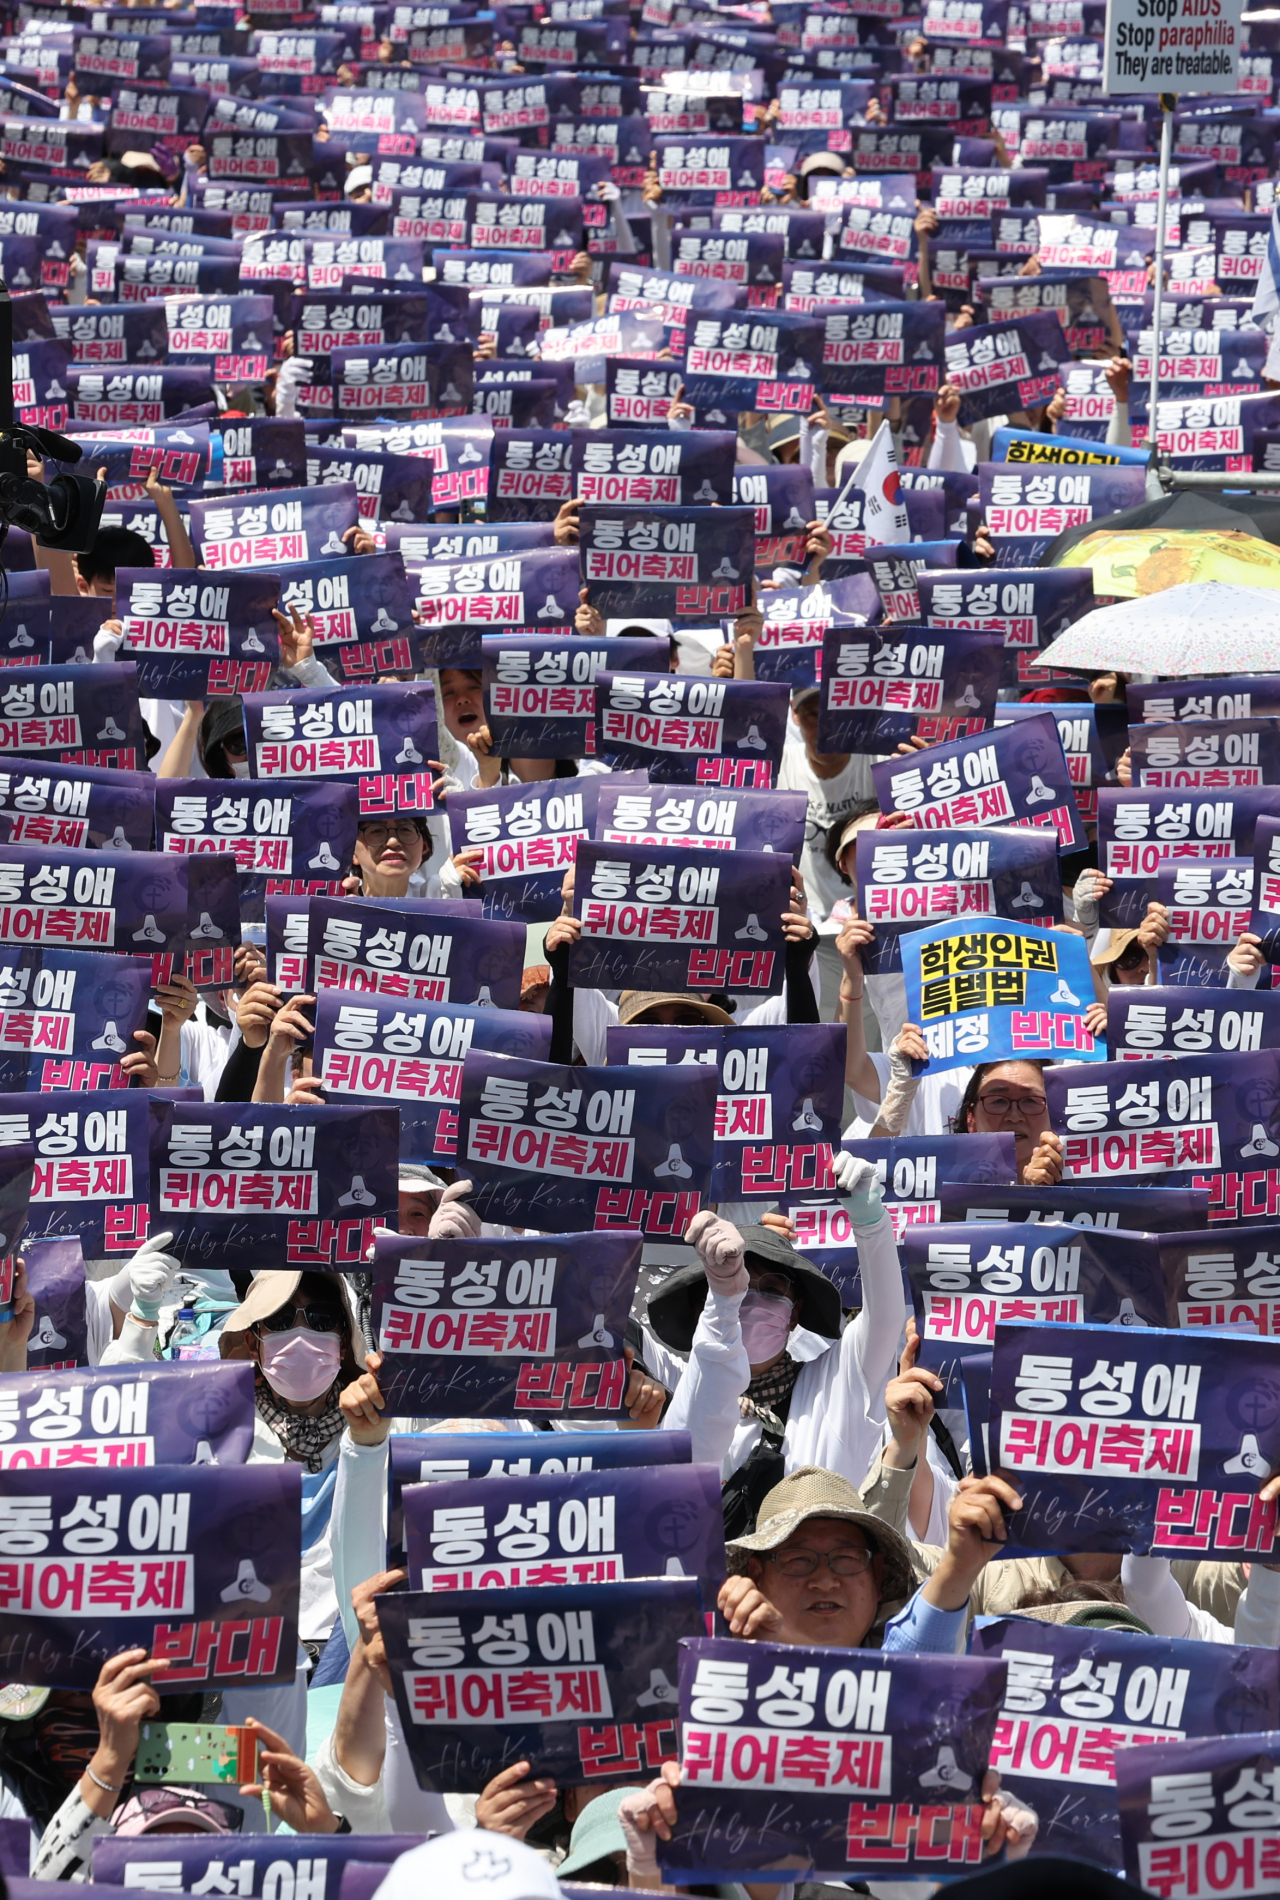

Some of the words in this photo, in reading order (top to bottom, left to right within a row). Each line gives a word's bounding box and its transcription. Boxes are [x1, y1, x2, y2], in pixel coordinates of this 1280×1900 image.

[1117, 21, 1154, 51] Stop
[1159, 20, 1234, 51] paraphilia
[1116, 51, 1147, 81] They
[1152, 57, 1172, 74] are
[1176, 52, 1232, 75] treatable.
[212, 160, 276, 176] 퀴어축제
[379, 162, 446, 189] 동성애
[516, 156, 578, 179] 동성애
[662, 170, 727, 187] 퀴어축제
[515, 178, 576, 196] 퀴어축제
[816, 180, 880, 197] 동성애
[940, 175, 1009, 198] 동성애
[400, 197, 467, 220] 동성애
[476, 202, 545, 226] 동성애
[850, 210, 912, 236] 동성애
[937, 198, 1006, 217] 퀴어축제
[398, 220, 464, 240] 퀴어축제
[474, 228, 542, 246] 퀴어축제
[845, 231, 908, 254] 퀴어축제
[311, 240, 384, 264] 동성애
[679, 239, 748, 260] 동성애
[1040, 246, 1114, 266] 퀴어축제
[124, 260, 199, 283] 동성애
[444, 260, 513, 284] 동성애
[678, 261, 745, 281] 퀴어축제
[791, 271, 863, 296] 동성애
[1100, 270, 1146, 294] 반대
[302, 305, 382, 330] 동성애
[826, 314, 902, 340] 동성애
[694, 321, 778, 350] 동성애
[824, 343, 900, 362] 퀴어축제
[946, 330, 1021, 363] 동성애
[216, 356, 267, 381] 반대
[344, 357, 426, 384] 동성애
[690, 351, 775, 376] 퀴어축제
[884, 366, 939, 392] 반대
[949, 354, 1029, 388] 퀴어축제
[78, 375, 162, 400] 동성애
[341, 387, 425, 406] 퀴어축제
[756, 384, 815, 411] 반대
[76, 404, 161, 422] 퀴어축제
[584, 442, 681, 474] 동성애
[1158, 432, 1242, 455] 퀴어축제
[131, 448, 200, 484] 반대
[432, 468, 488, 502] 반대
[580, 475, 678, 502] 퀴어축제
[990, 476, 1089, 502] 동성애
[204, 502, 302, 538] 동성애
[592, 519, 695, 552] 동성애
[204, 534, 304, 568] 퀴어축제
[589, 551, 696, 580] 퀴어축제
[420, 560, 520, 594] 동성애
[131, 582, 229, 618] 동성애
[419, 590, 520, 625] 퀴어축제
[676, 585, 744, 614] 반대
[932, 584, 1034, 614] 동성애
[126, 620, 226, 654] 퀴어축제
[341, 635, 411, 678] 반대
[496, 651, 606, 682] 동성애
[836, 645, 944, 675] 동성애
[208, 660, 270, 694] 반대
[610, 676, 725, 716] 동성애
[829, 679, 942, 711] 퀴어축제
[261, 700, 372, 739] 동성애
[602, 711, 722, 750] 퀴어축제
[259, 736, 375, 775] 퀴어축제
[1146, 734, 1258, 765] 동성애
[696, 758, 772, 788] 반대
[890, 746, 999, 810] 동성애
[359, 772, 434, 812] 반대
[171, 798, 292, 835] 동성애
[465, 794, 584, 841] 동성애
[613, 790, 737, 835] 동성애
[1112, 802, 1234, 839] 동성애
[872, 841, 989, 880] 동성애
[0, 865, 114, 905] 동성애
[591, 861, 720, 906] 동성애
[869, 882, 989, 919] 퀴어축제
[582, 903, 718, 942] 퀴어축제
[324, 918, 450, 975] 동성애
[921, 935, 1056, 974] 학생인권
[688, 949, 775, 988] 반대
[922, 974, 1026, 1018] 특별법
[335, 1008, 475, 1056] 동성애
[925, 1018, 989, 1059] 제정
[1012, 1011, 1092, 1050] 반대
[1124, 1006, 1264, 1050] 동성애
[322, 1052, 462, 1099] 퀴어축제
[481, 1078, 636, 1135] 동성애
[1065, 1078, 1212, 1131] 동성애
[168, 1124, 316, 1169] 동성애
[472, 1122, 631, 1178] 퀴어축제
[1066, 1125, 1214, 1174] 퀴어축제
[742, 1145, 836, 1192] 반대
[162, 1172, 315, 1210] 퀴어축제
[467, 1180, 530, 1215] Holy
[529, 1182, 589, 1210] Korea
[595, 1188, 701, 1236] 반대
[286, 1218, 376, 1264] 반대
[394, 1258, 556, 1305] 동성애
[928, 1245, 1081, 1291] 동성애
[384, 1308, 551, 1352] 퀴어축제
[382, 1372, 445, 1412] Holy
[445, 1372, 512, 1398] Korea
[515, 1361, 625, 1409] 반대
[1014, 1356, 1201, 1420] 동성애
[1002, 1416, 1196, 1475] 퀴어축제
[1072, 1490, 1152, 1522] Korea
[1154, 1489, 1278, 1552] 반대
[0, 1494, 191, 1554] 동성애
[430, 1498, 615, 1562] 동성애
[0, 1558, 188, 1611] 퀴어축제
[152, 1618, 284, 1682] 반대
[409, 1611, 596, 1665] 동성애
[414, 1672, 602, 1720] 퀴어축제
[690, 1660, 891, 1732] 동성애
[1002, 1650, 1190, 1728] 동성애
[685, 1728, 885, 1789] 퀴어축제
[675, 1805, 755, 1852] Holy
[752, 1805, 832, 1842] Korea
[848, 1802, 982, 1864] 반대
